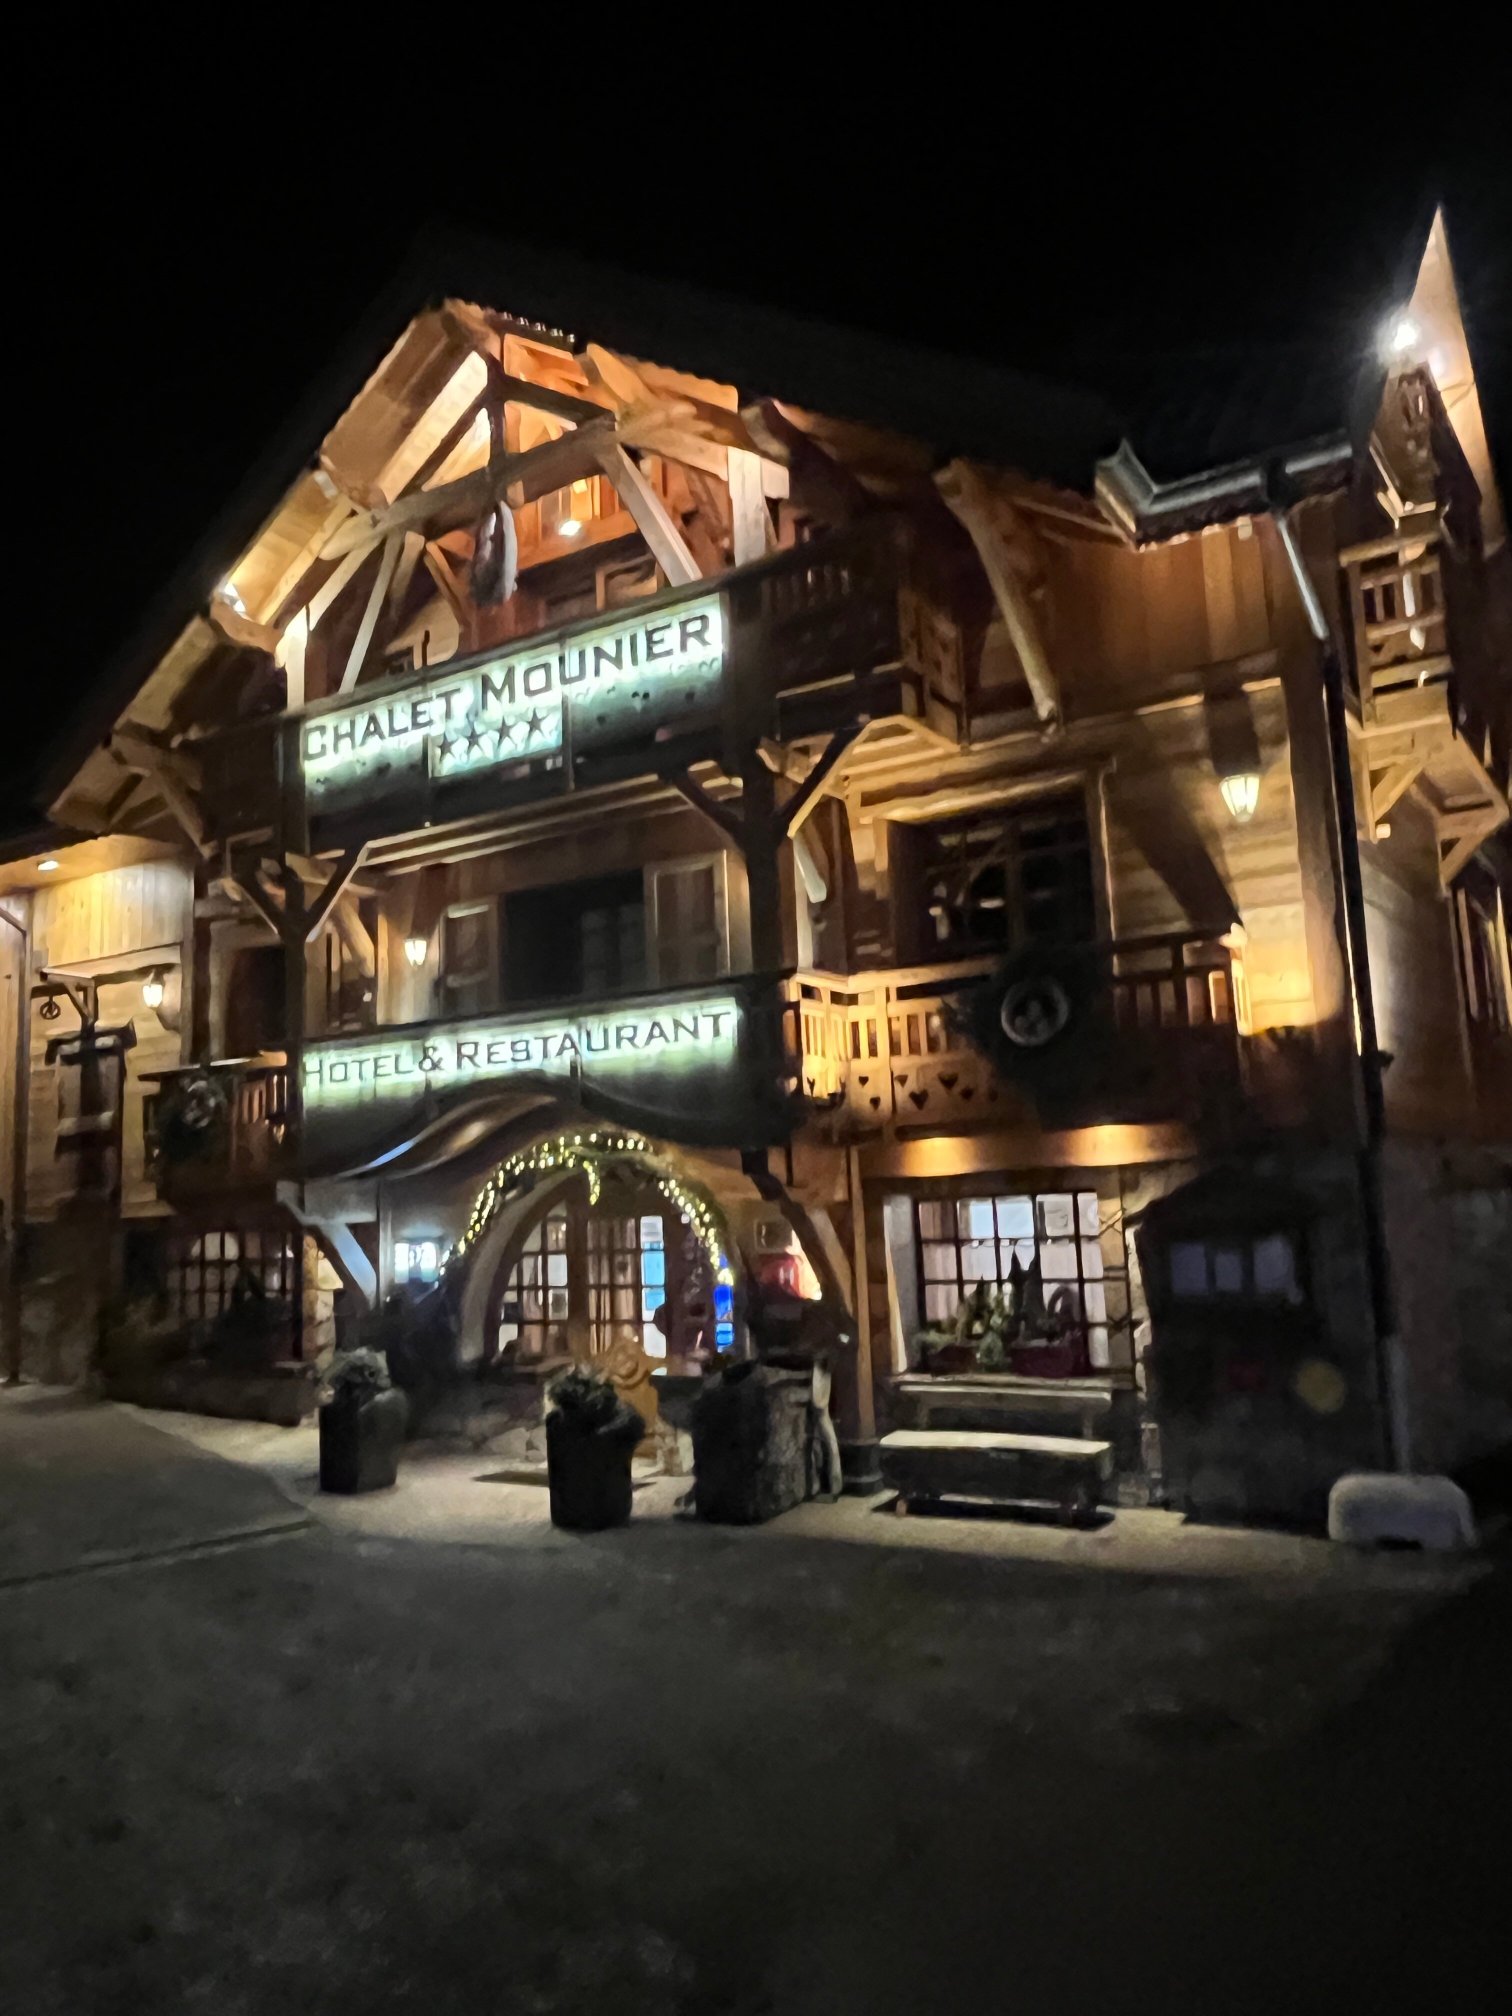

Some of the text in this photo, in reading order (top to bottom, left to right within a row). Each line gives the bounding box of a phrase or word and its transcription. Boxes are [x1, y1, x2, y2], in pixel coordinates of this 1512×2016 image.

[302, 613, 712, 762] CHALET MOUNIER
[302, 1053, 414, 1087] HOTEL
[456, 1010, 732, 1070] RESTAURANT
